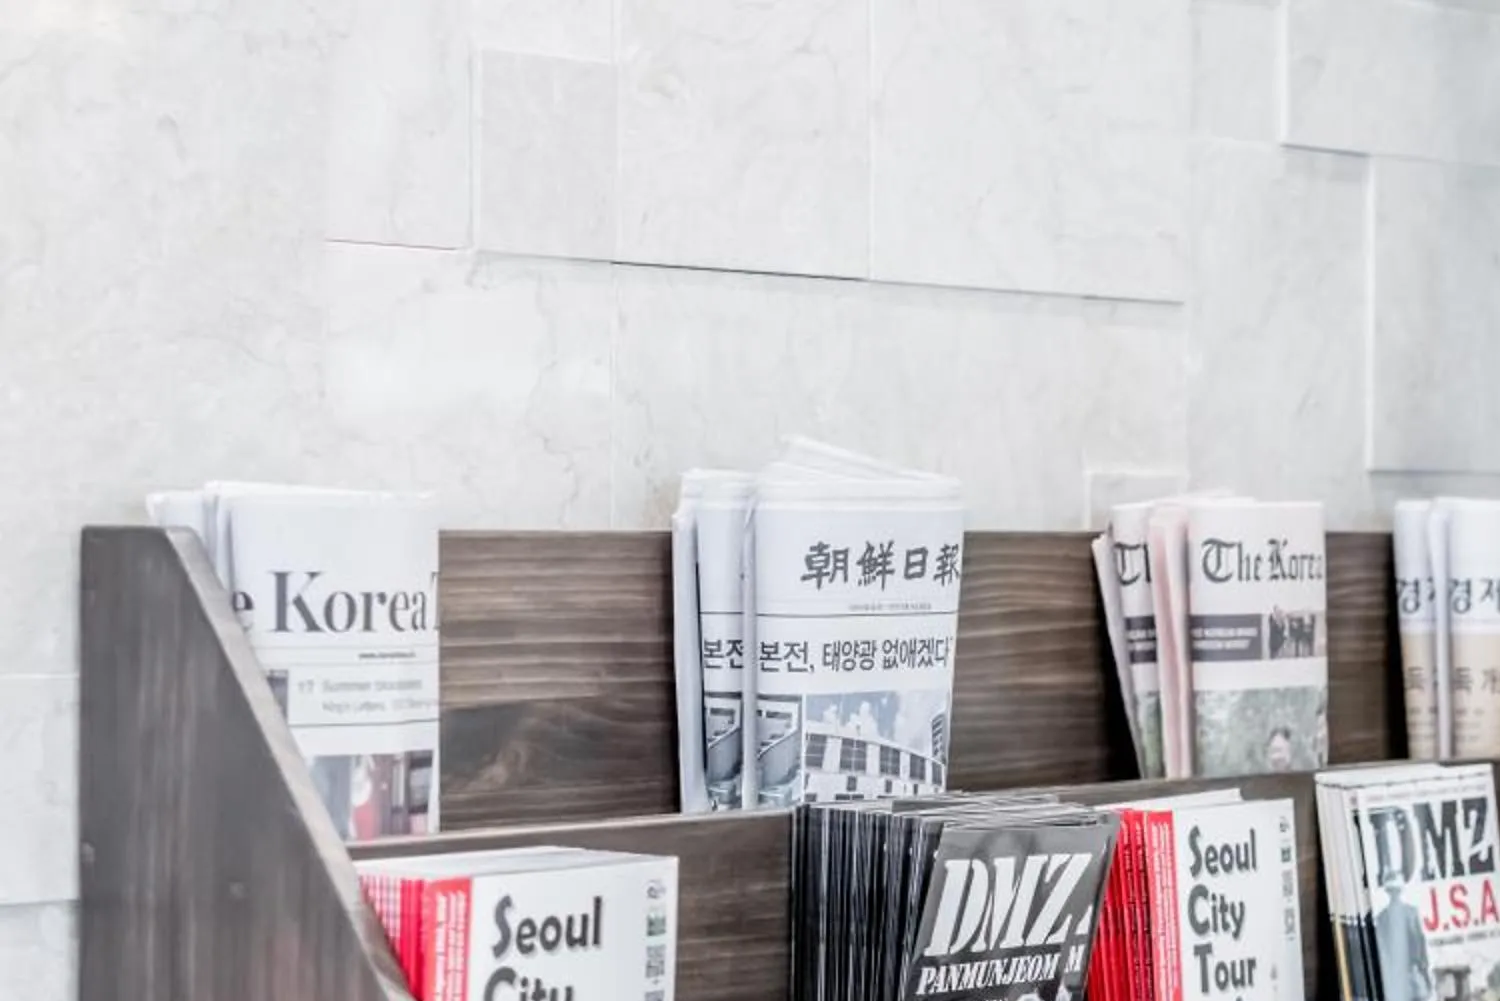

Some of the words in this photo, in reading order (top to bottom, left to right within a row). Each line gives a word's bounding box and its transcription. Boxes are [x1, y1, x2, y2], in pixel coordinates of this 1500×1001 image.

[800, 539, 960, 591] 朝鮮日報
[1201, 537, 1261, 584] The
[267, 571, 428, 634] Korea
[759, 640, 815, 674] 본전,
[822, 638, 877, 673] 태양광
[1188, 825, 1257, 878] Seoul
[1367, 796, 1496, 888] DMZ
[492, 895, 603, 959] Seoul
[924, 853, 1092, 957] DMZ
[1187, 883, 1246, 940] City
[1423, 879, 1500, 932] J.S.A
[916, 953, 1061, 996] PANMUNJEOM
[1194, 942, 1257, 995] Tour
